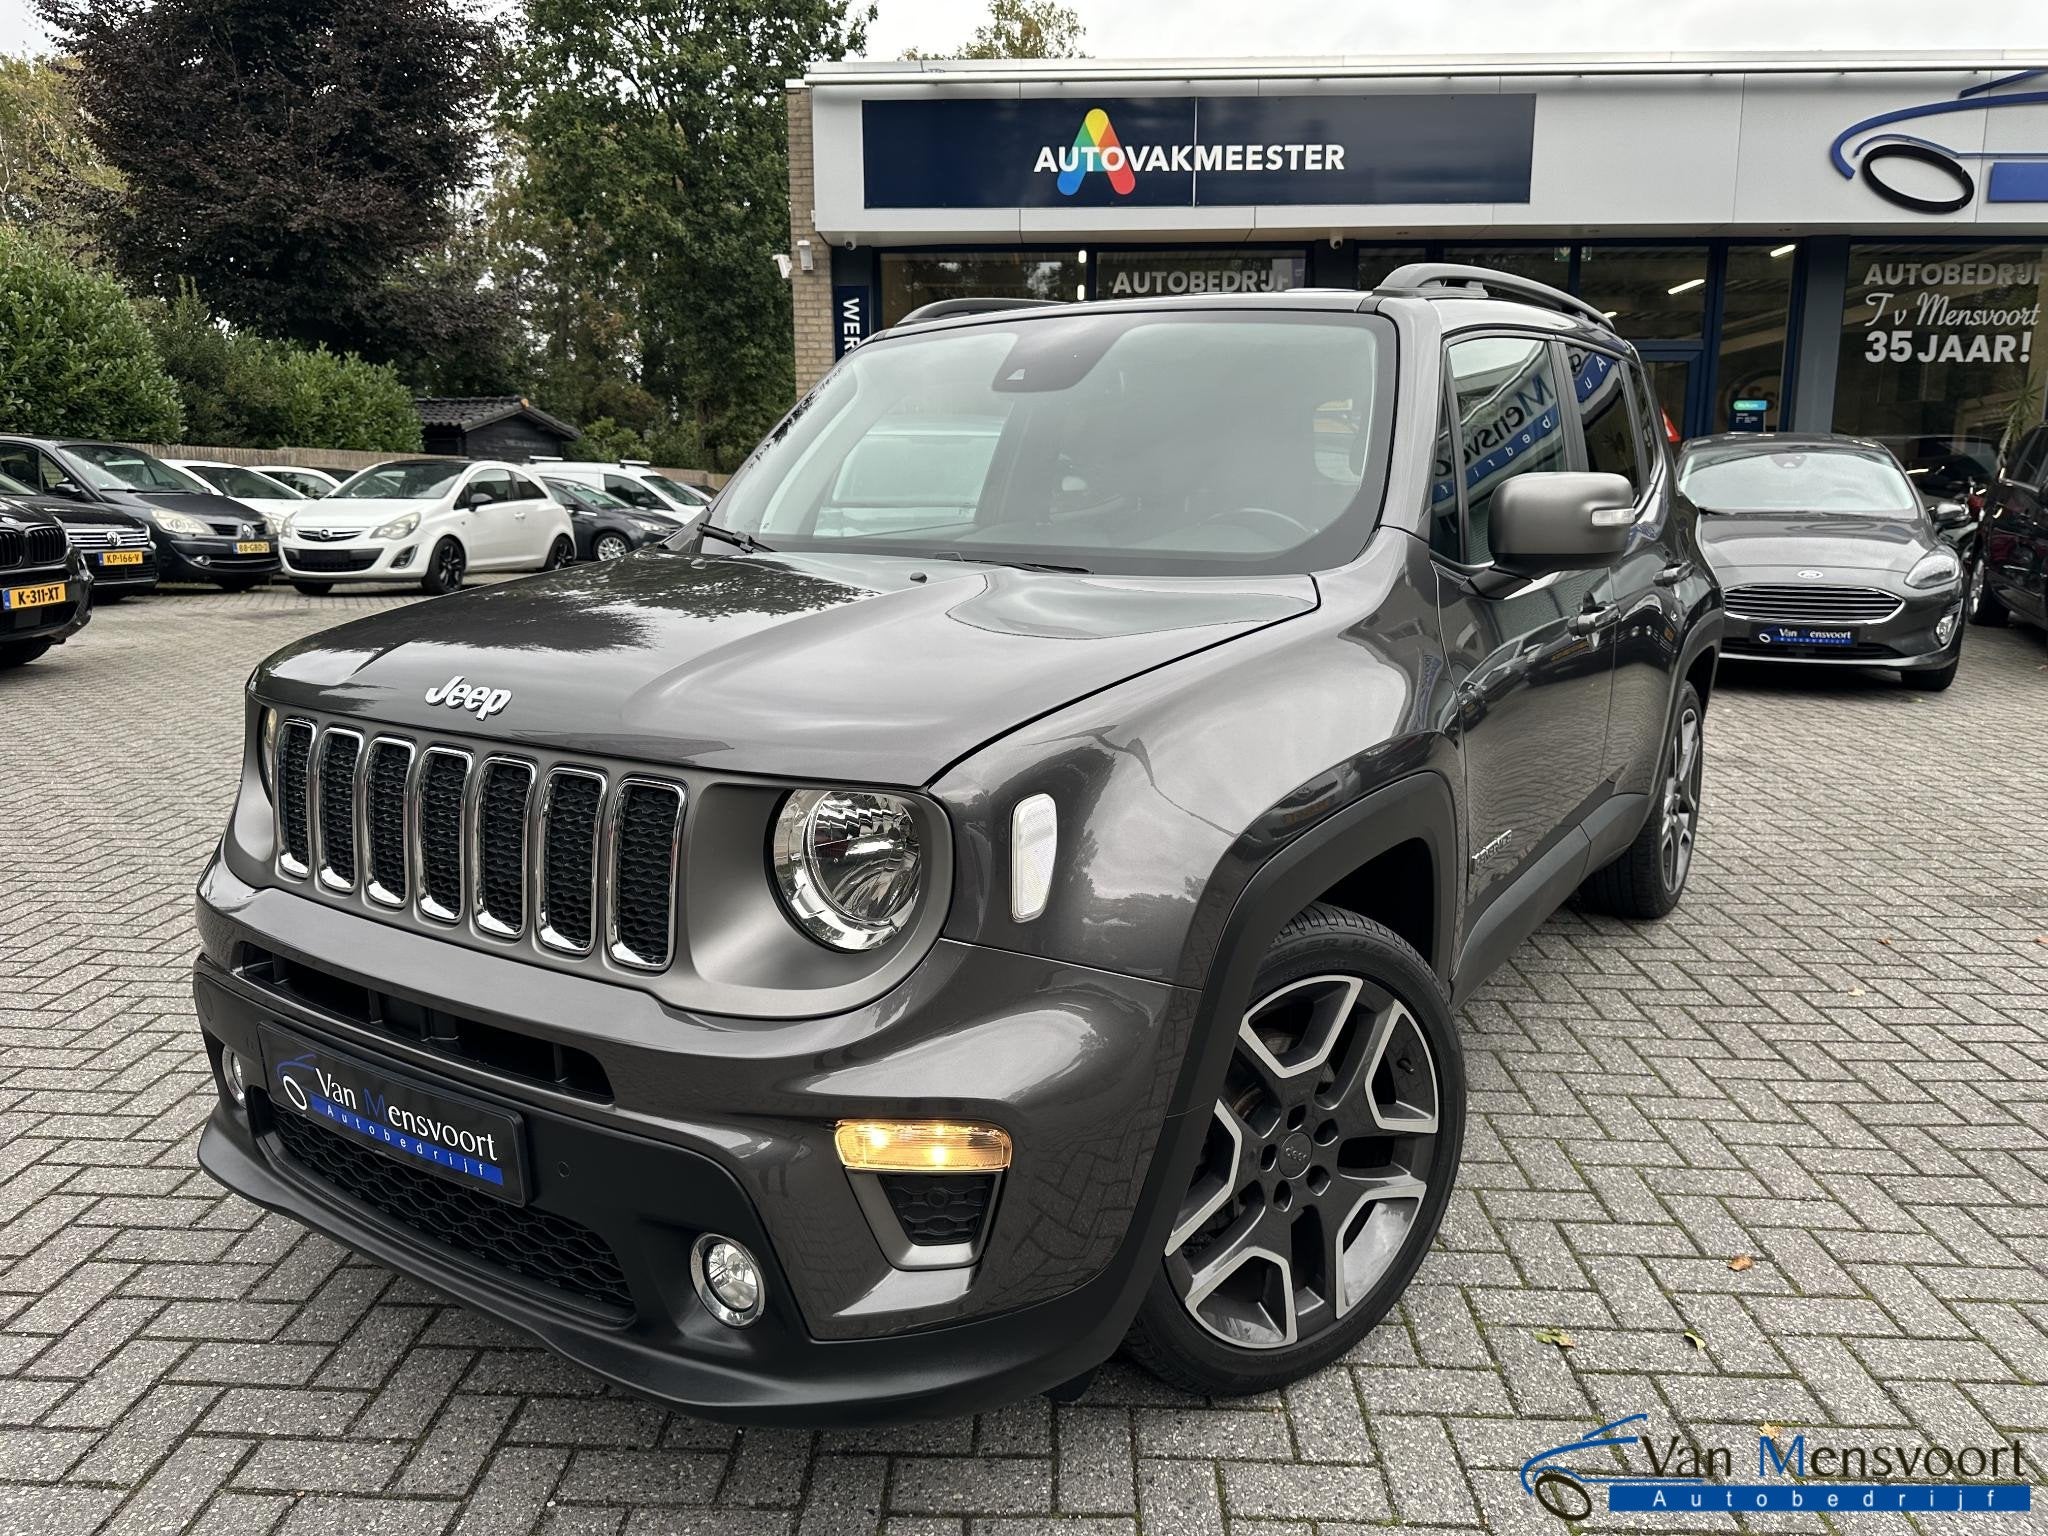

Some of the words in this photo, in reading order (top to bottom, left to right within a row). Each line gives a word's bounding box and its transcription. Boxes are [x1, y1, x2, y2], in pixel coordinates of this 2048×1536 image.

[1033, 144, 1345, 172] AUTOVAKMEESTER
[1916, 291, 2042, 326] Mensvoort
[1864, 330, 1913, 363] 35
[1917, 331, 2033, 363] JAAR!
[106, 553, 140, 564] KP-166-V
[18, 586, 60, 606] K-311-XT
[1779, 628, 1798, 638] Van
[425, 675, 512, 721] Jeep
[315, 1067, 357, 1110] Van
[363, 1087, 499, 1161] Mensvoort
[326, 1103, 485, 1176] Autobedrijf
